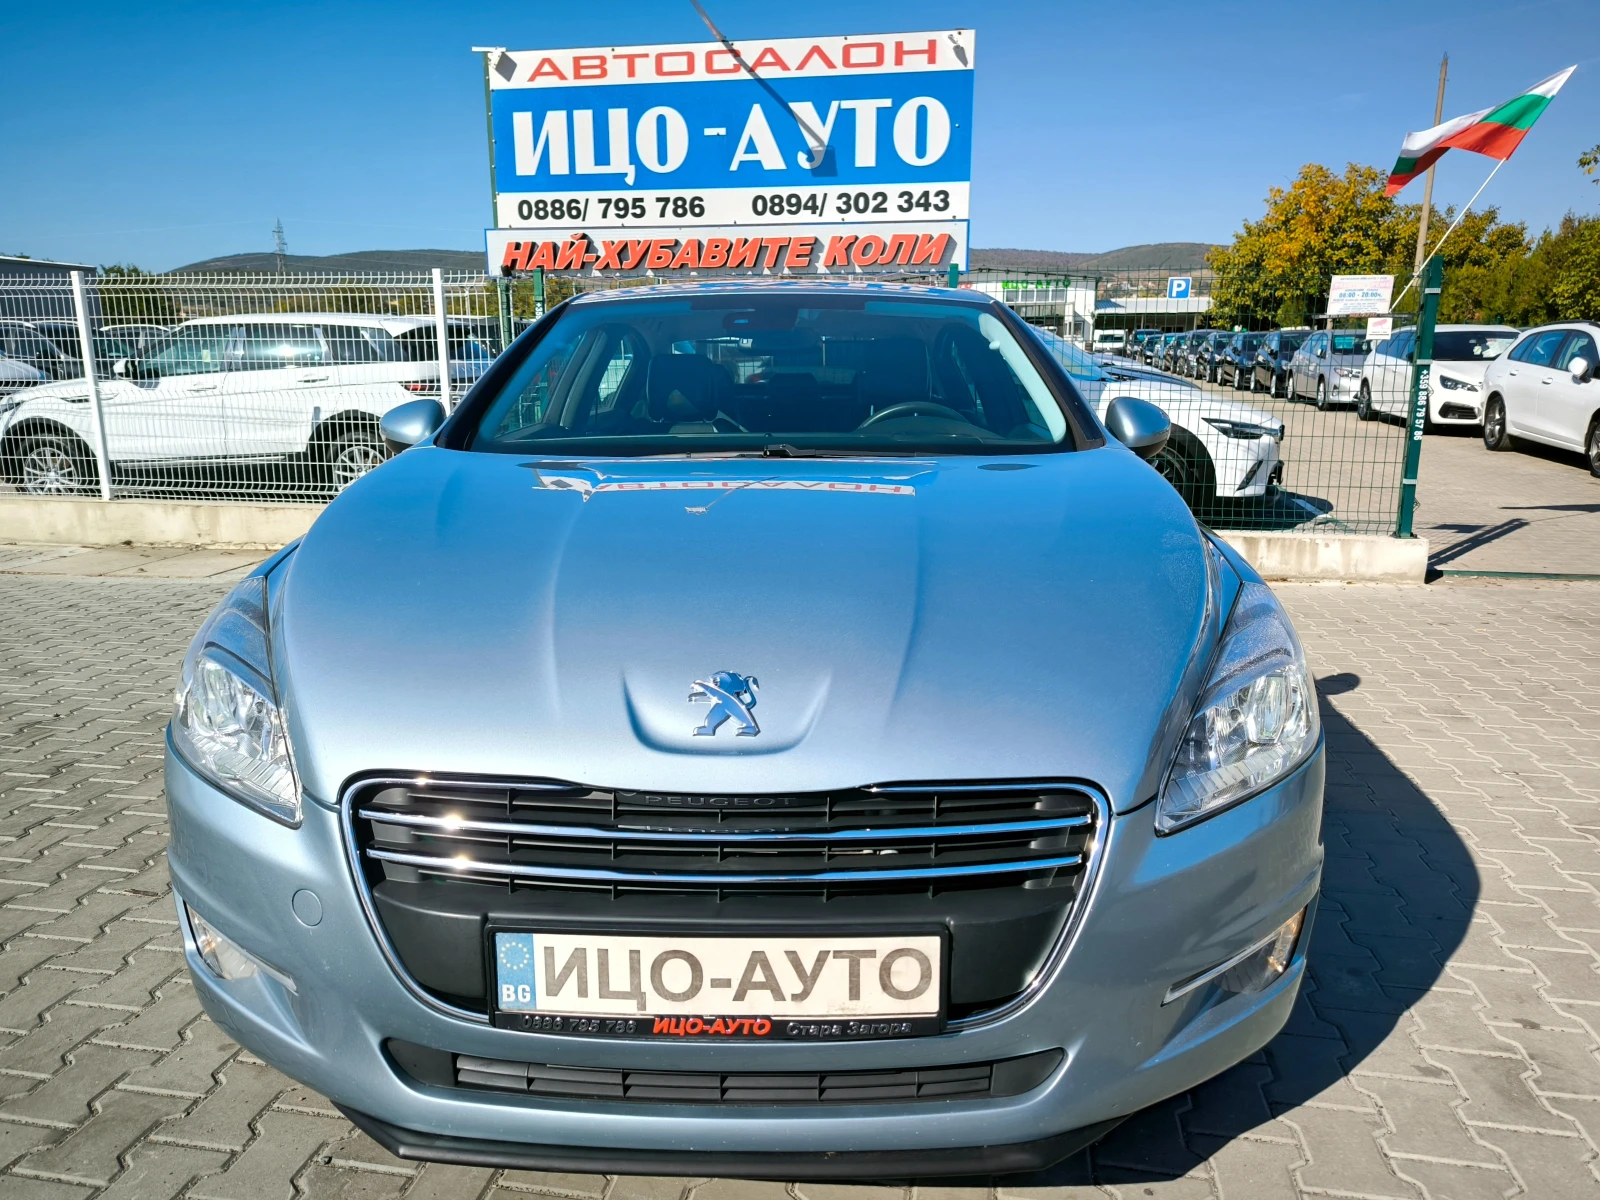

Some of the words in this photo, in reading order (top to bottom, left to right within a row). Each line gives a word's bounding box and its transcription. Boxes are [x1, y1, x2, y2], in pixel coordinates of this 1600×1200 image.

[527, 39, 937, 82] АВТОСАЛОН
[517, 198, 589, 222] 0886/
[598, 198, 646, 220] 795
[658, 196, 705, 219] 786
[752, 193, 827, 217] 0894/
[836, 192, 888, 214] 302
[896, 190, 950, 213] 343
[502, 233, 827, 270] НАЙ-ХУБАВИТЕ
[823, 233, 950, 267] КОЛИ
[1172, 280, 1186, 297] P
[1418, 369, 1429, 389] +359
[1417, 391, 1428, 406] 886
[1416, 407, 1426, 418] 79
[1414, 419, 1425, 429] 57
[1413, 430, 1423, 441] 86
[645, 795, 796, 806] PEUGEOT
[543, 946, 932, 1011] ИЦО-АУТО
[502, 984, 531, 1003] BG
[569, 1017, 600, 1033] 795
[601, 1018, 637, 1034] 786
[651, 1016, 772, 1036] ИЦО-АУТО
[786, 1021, 842, 1038] Стара
[847, 1020, 912, 1037] Загора
